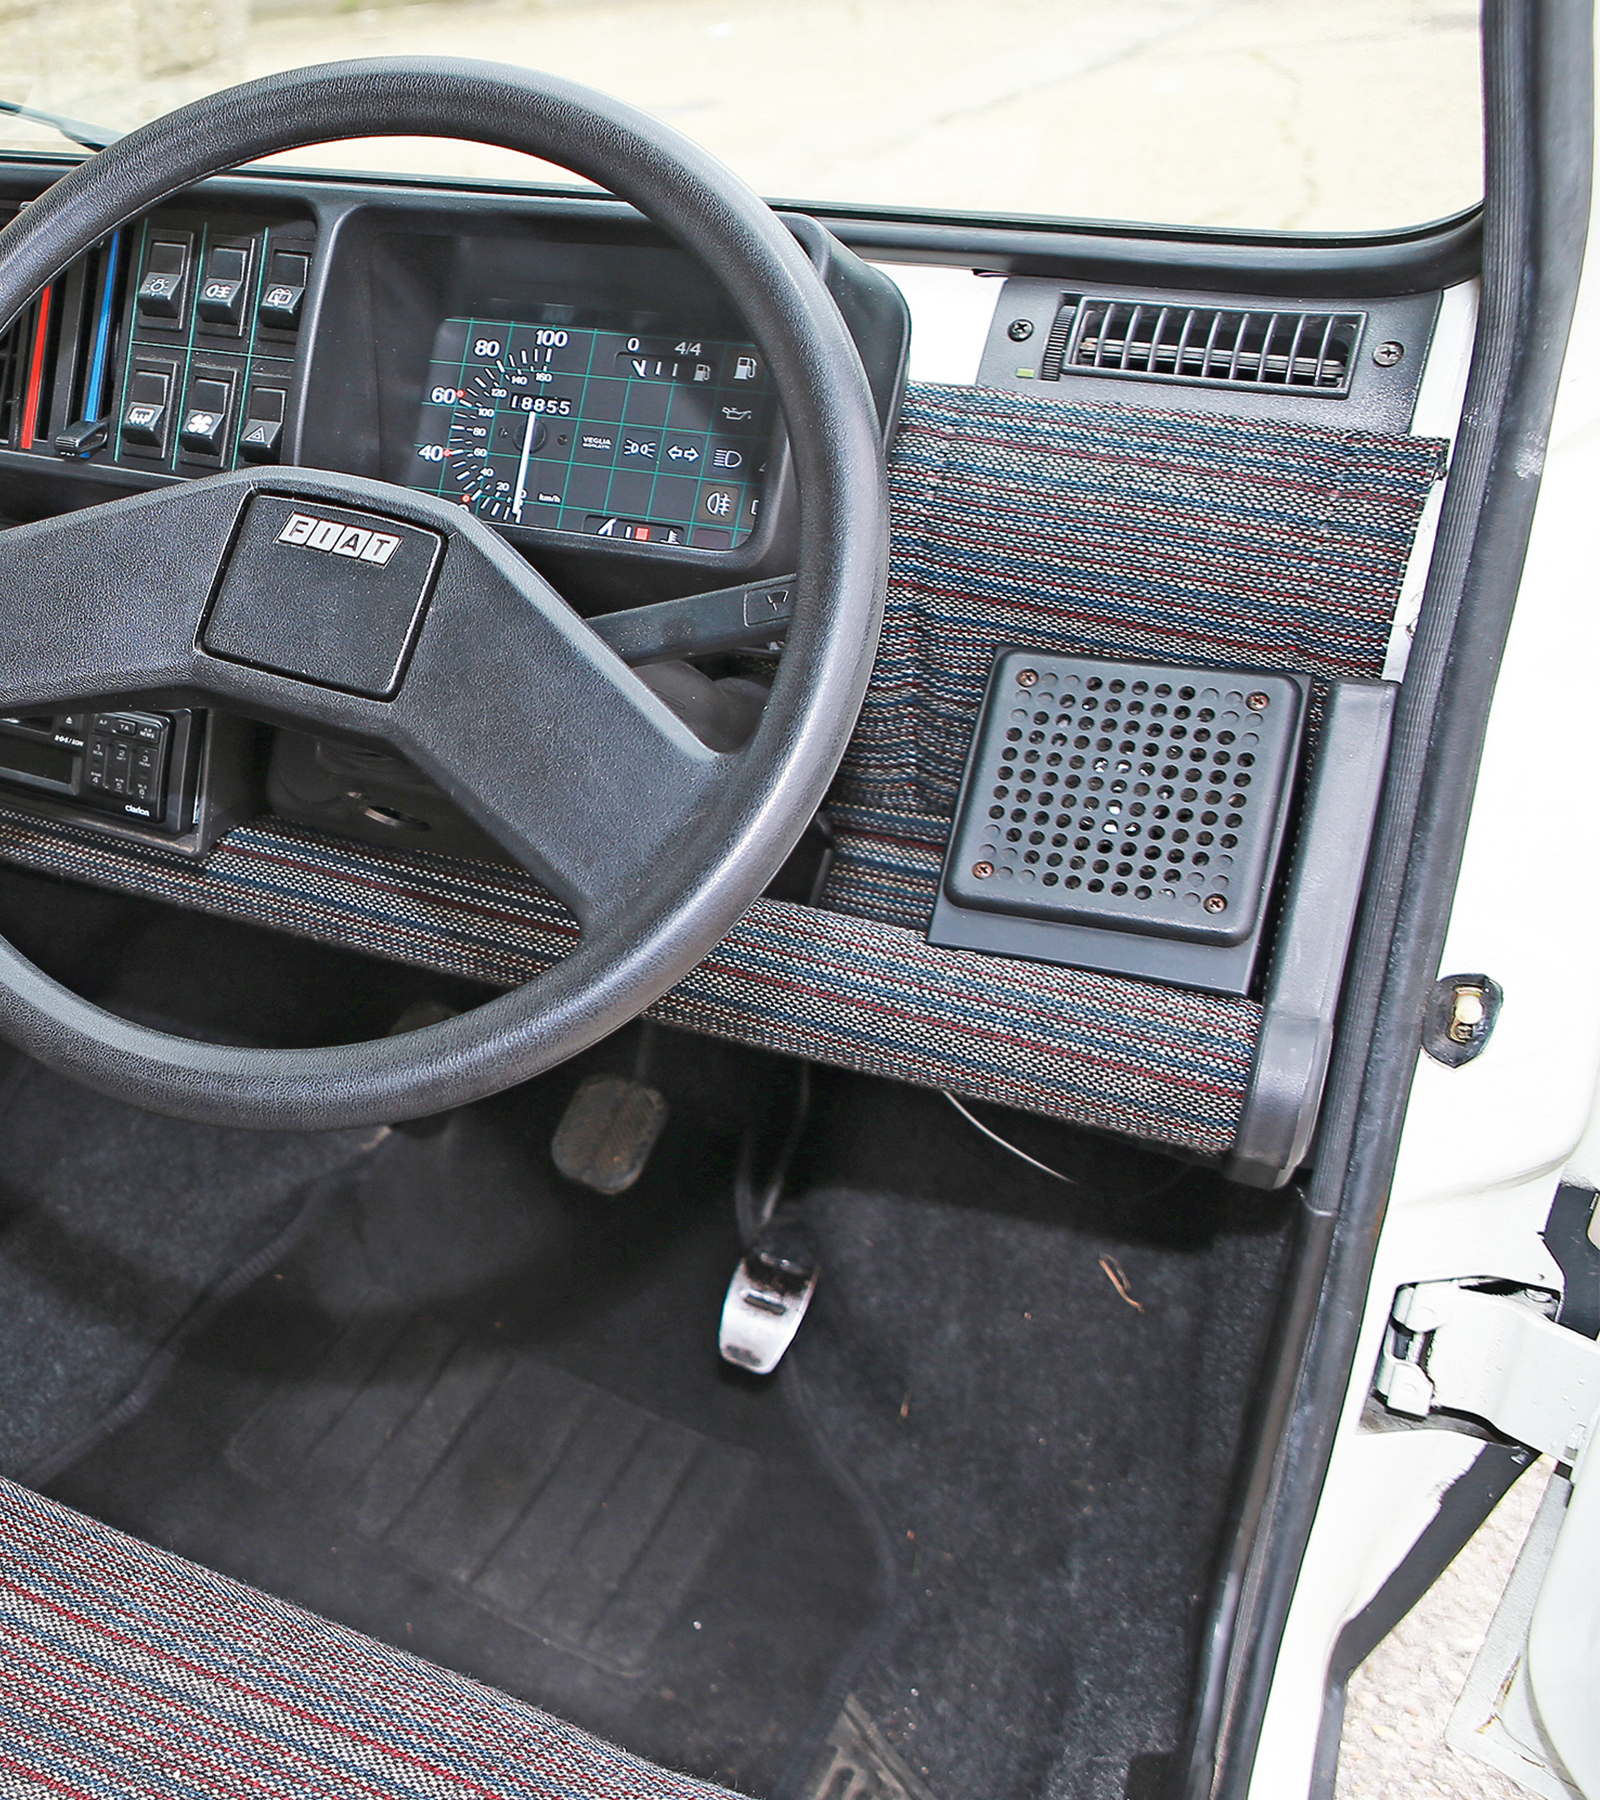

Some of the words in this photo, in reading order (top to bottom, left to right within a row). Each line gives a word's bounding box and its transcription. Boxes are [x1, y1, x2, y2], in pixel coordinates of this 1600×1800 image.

[535, 329, 568, 347] 100
[474, 339, 499, 357] 80
[627, 337, 640, 352] 0
[674, 341, 702, 356] 4/4
[511, 375, 528, 385] 140
[536, 372, 552, 383] 160
[431, 387, 456, 404] 60
[490, 388, 507, 398] 120
[511, 395, 571, 415] 18855
[477, 408, 495, 418] 100
[473, 427, 487, 437] 80
[582, 436, 612, 445] VEGLIA
[418, 445, 443, 462] 40
[473, 447, 488, 457] 60
[480, 468, 494, 478] 40
[496, 482, 510, 492] 20
[538, 493, 561, 503] km/h
[286, 517, 394, 559] FIAT
[139, 731, 155, 739] NEWS
